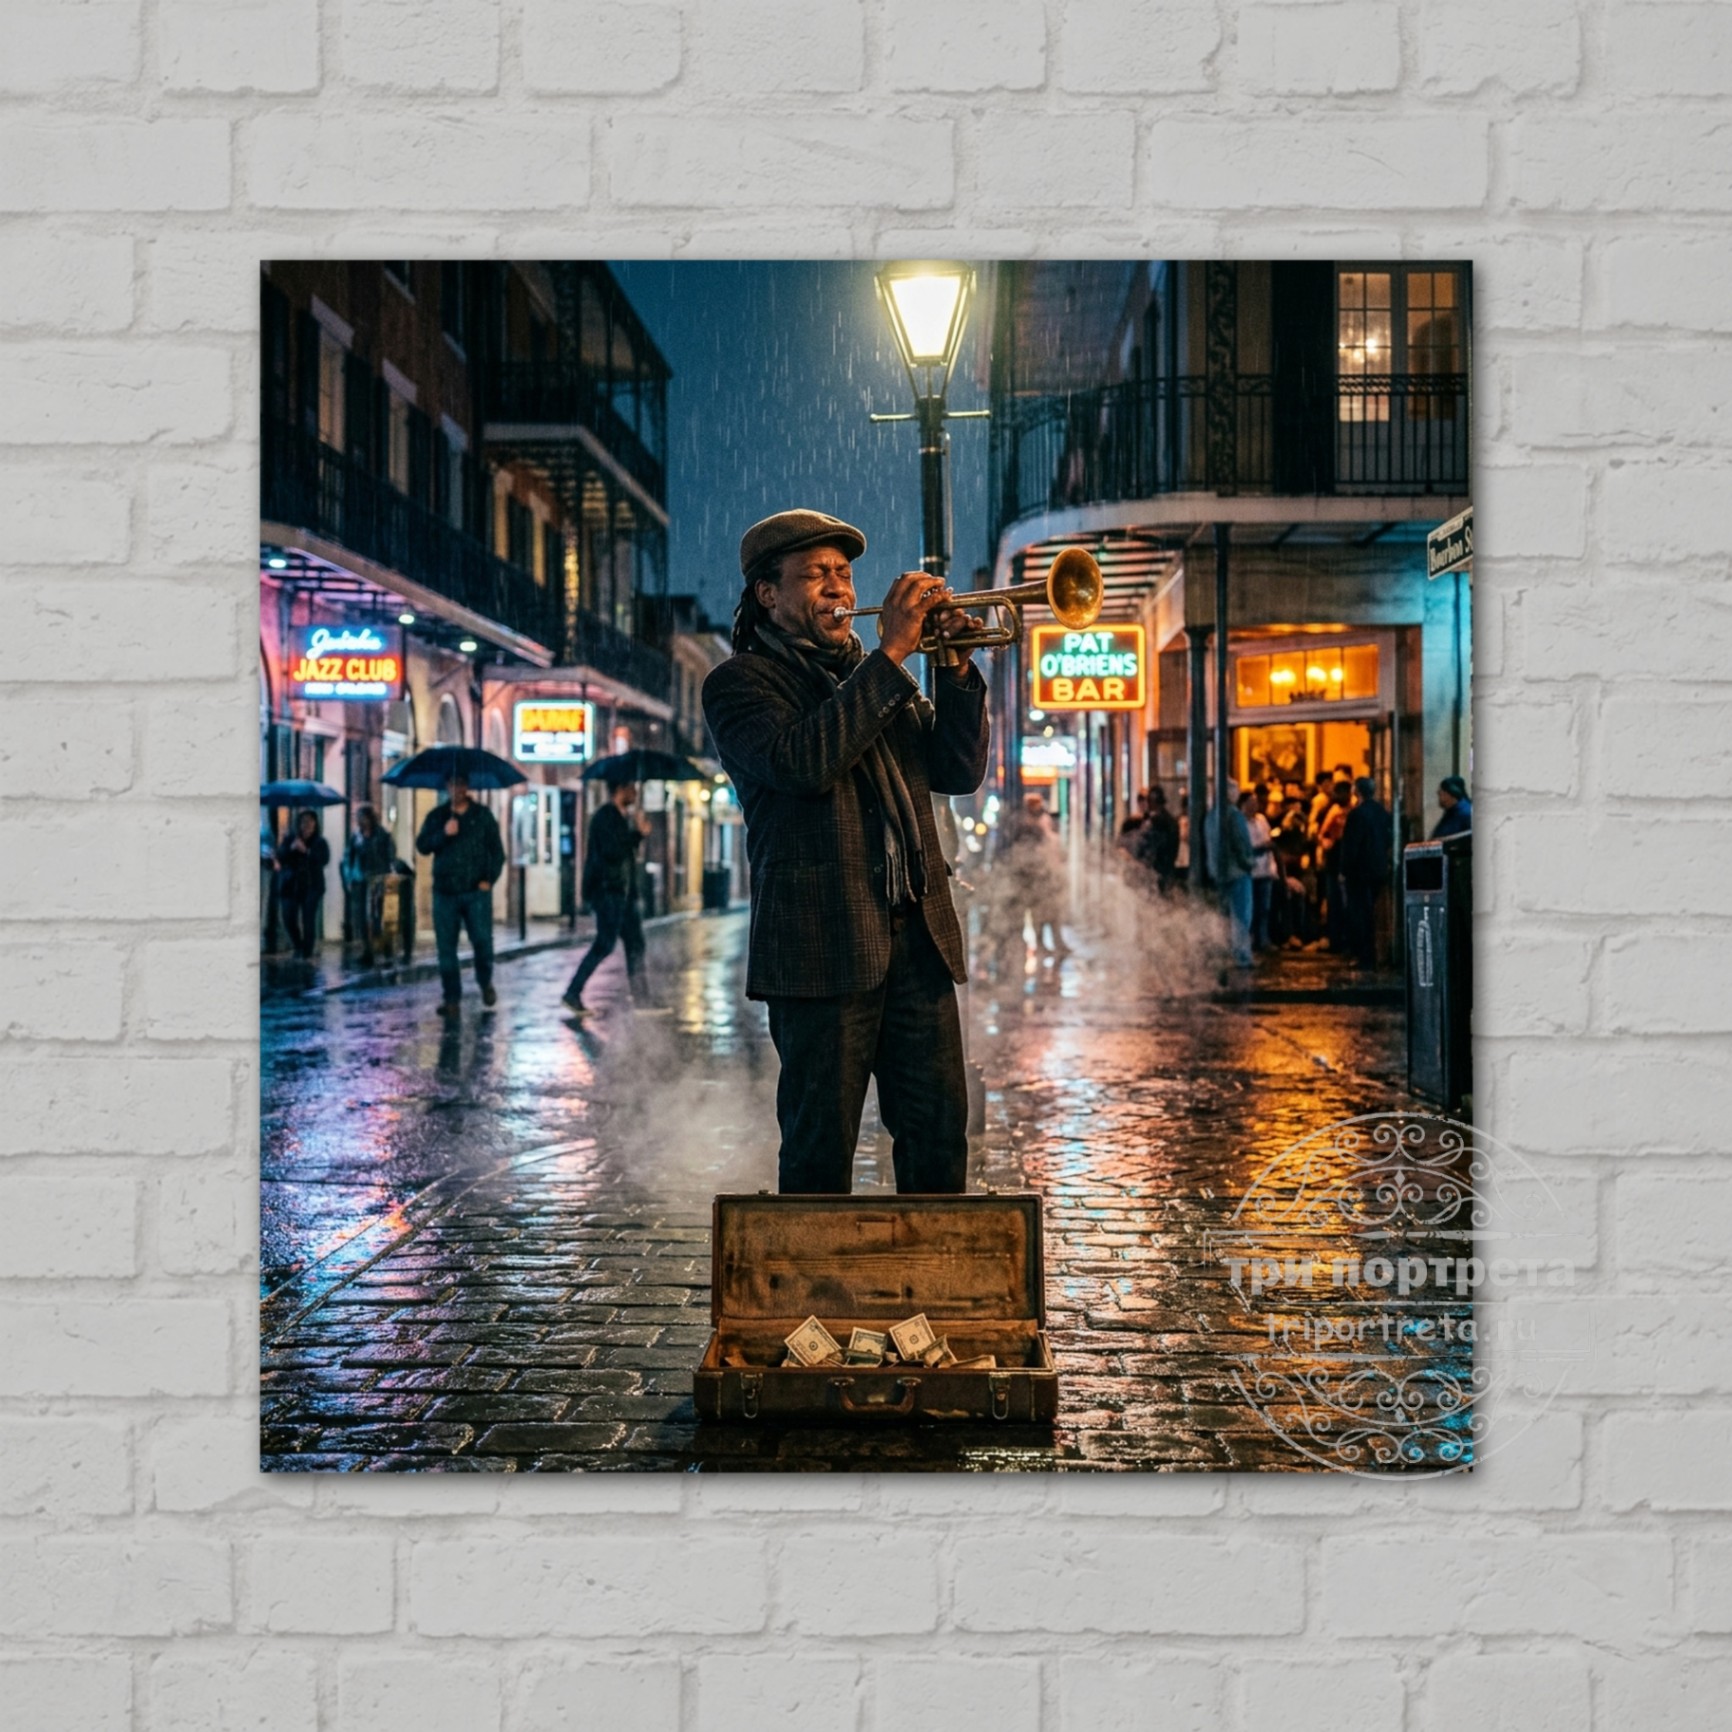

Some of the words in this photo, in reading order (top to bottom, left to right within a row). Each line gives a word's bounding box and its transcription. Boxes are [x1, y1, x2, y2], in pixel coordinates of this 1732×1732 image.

[1063, 632, 1114, 653] PAT
[293, 658, 343, 682] JAZZ
[346, 658, 397, 682] CLUB
[1040, 653, 1138, 677] O'BRIENS
[1052, 678, 1126, 701] BAR
